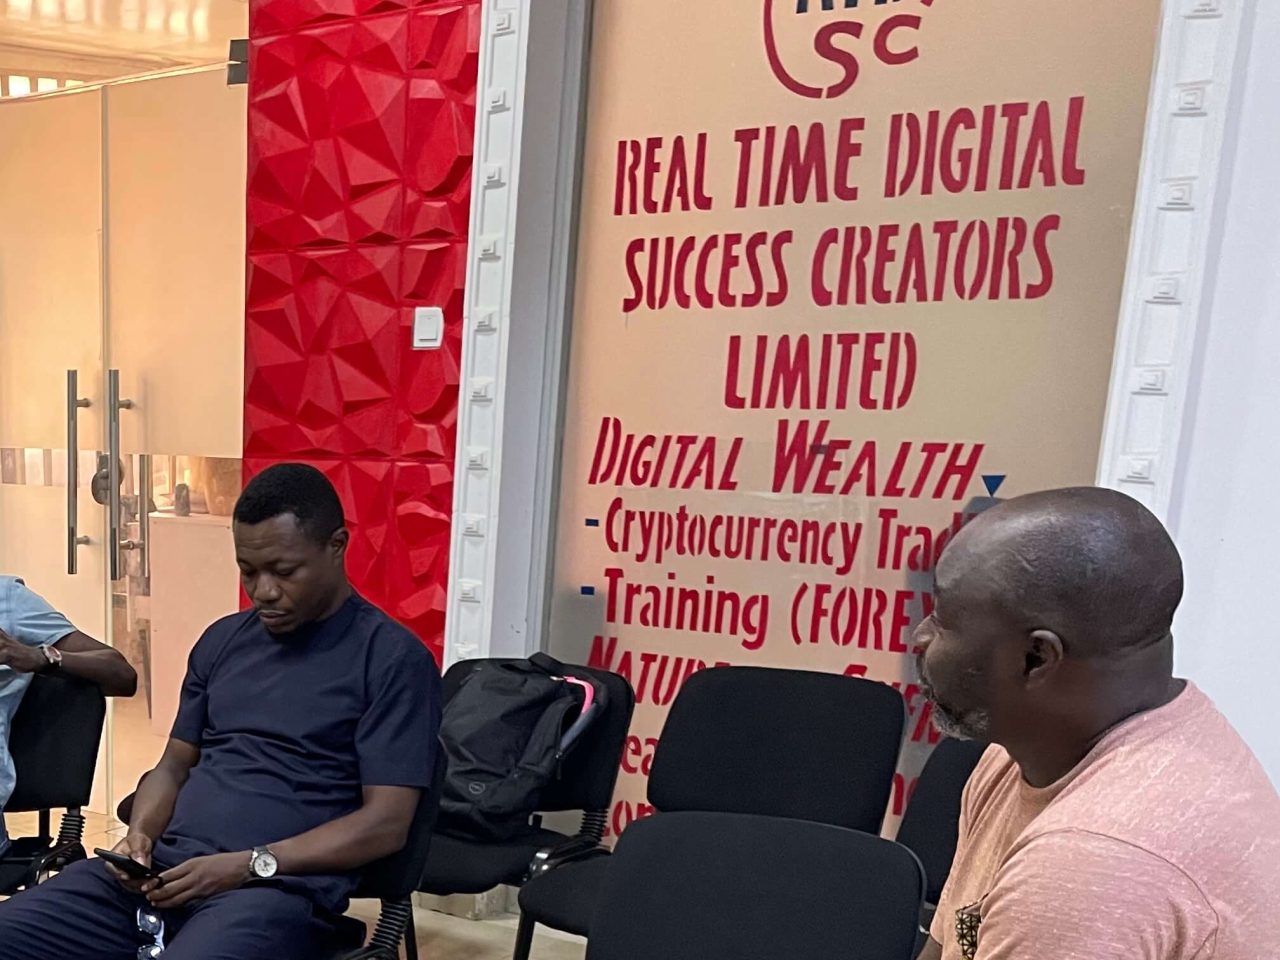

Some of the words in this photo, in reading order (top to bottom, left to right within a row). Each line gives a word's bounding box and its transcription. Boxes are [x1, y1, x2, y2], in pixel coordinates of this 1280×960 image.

[613, 131, 714, 216] REAL
[733, 117, 866, 209] TIME
[883, 96, 1086, 198] DIGITAL
[622, 229, 794, 313] SUCCESS
[810, 214, 1062, 307] CREATORS
[723, 331, 918, 411] LIMITED
[587, 416, 744, 491] DIGITAL
[771, 417, 986, 501] WEALTH
[605, 496, 863, 576] Cryptocurrency
[876, 508, 978, 572] Trad
[603, 567, 771, 652] Training
[790, 582, 936, 655] (FORE
